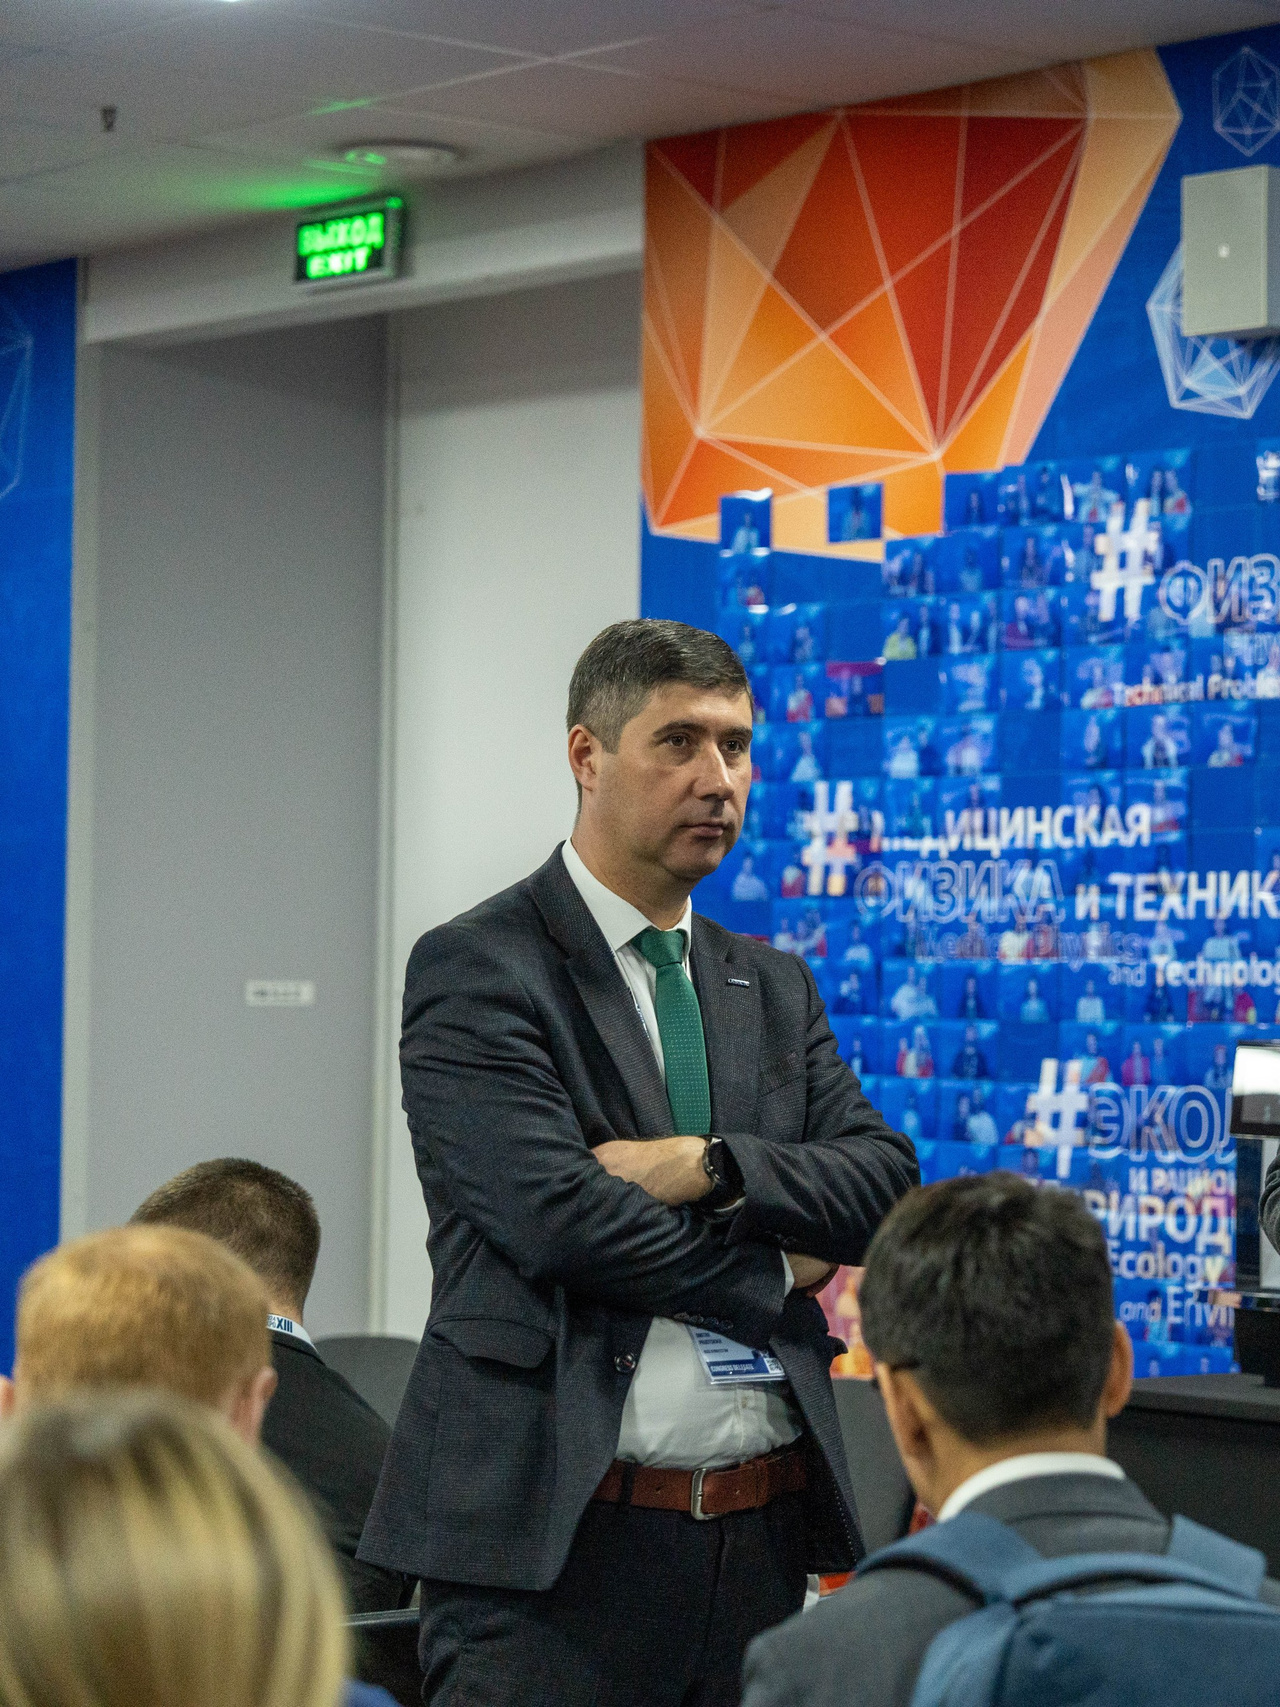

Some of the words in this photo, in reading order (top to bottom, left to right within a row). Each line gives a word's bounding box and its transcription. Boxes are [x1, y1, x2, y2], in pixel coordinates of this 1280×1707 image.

[869, 803, 1152, 860] ИЦИНСКАЯ
[853, 860, 1066, 923] ФИЗИКА
[1083, 1189, 1236, 1256] РИРОД
[276, 1317, 293, 1333] XIII
[1119, 1298, 1162, 1323] and
